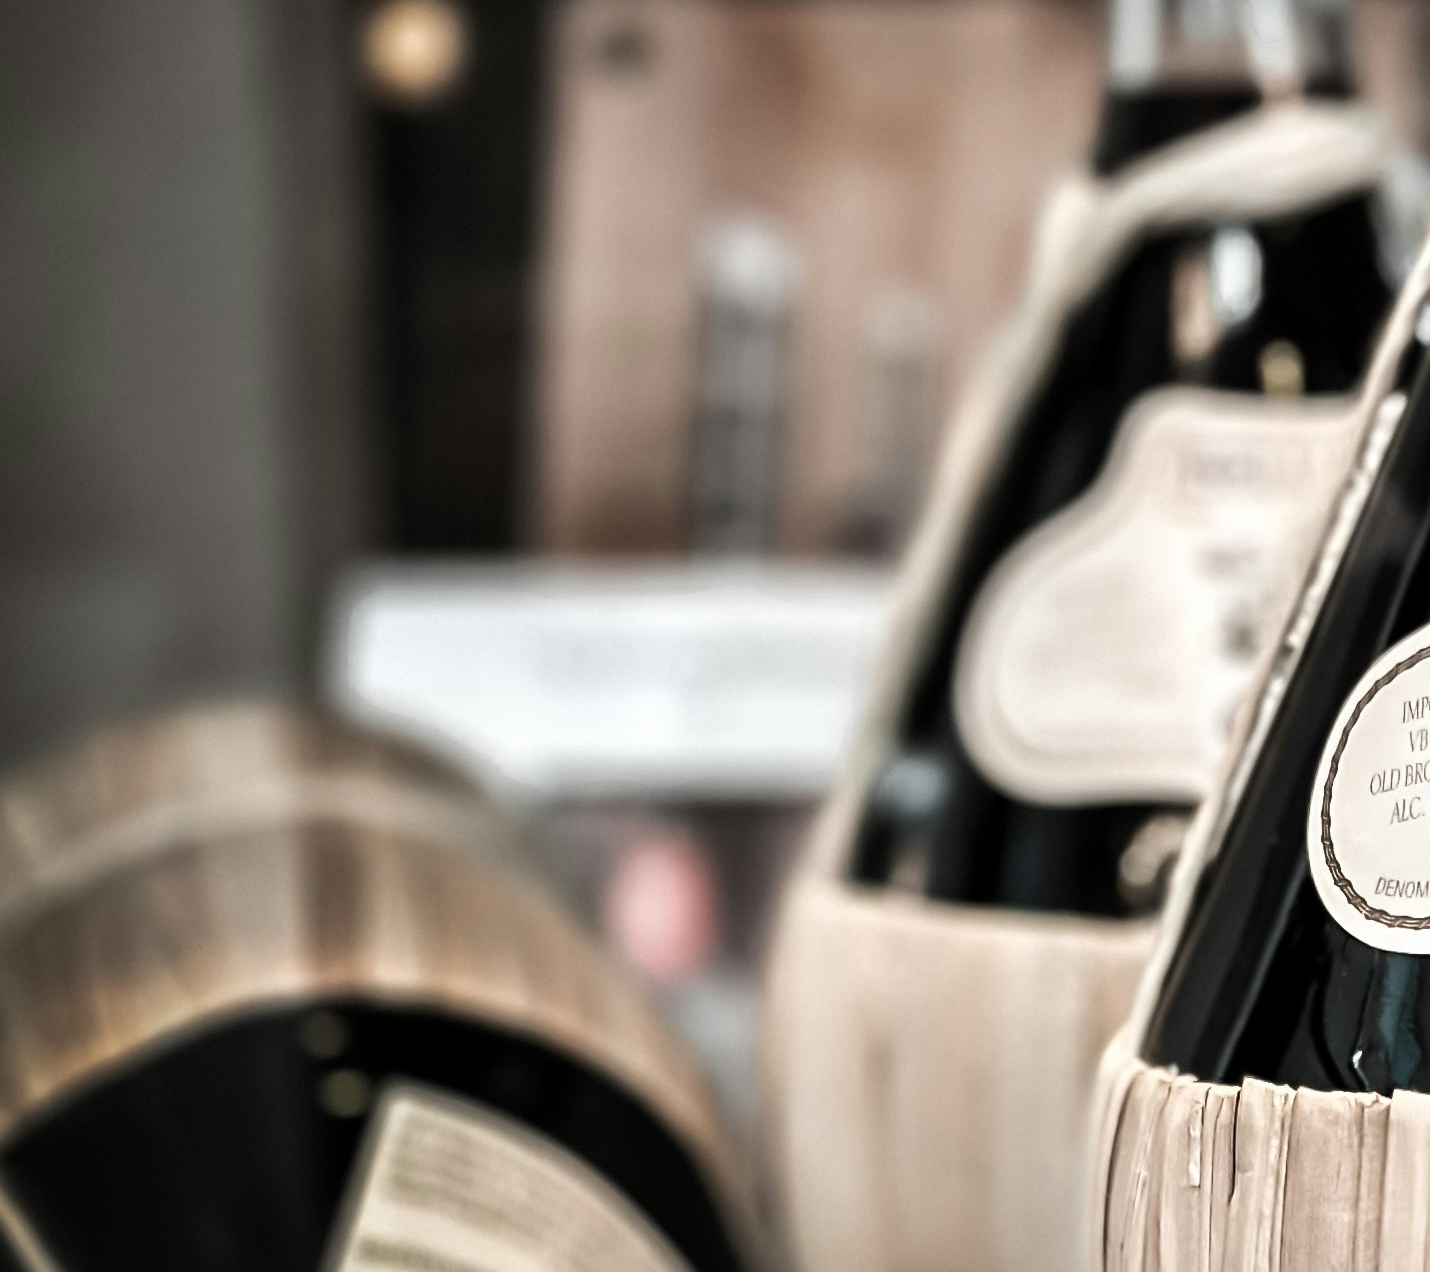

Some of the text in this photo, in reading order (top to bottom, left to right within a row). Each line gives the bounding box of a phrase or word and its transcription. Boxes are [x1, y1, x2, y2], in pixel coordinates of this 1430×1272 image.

[1409, 729, 1429, 753] VB
[1369, 768, 1401, 796] OLD
[1389, 796, 1425, 825] ALC.
